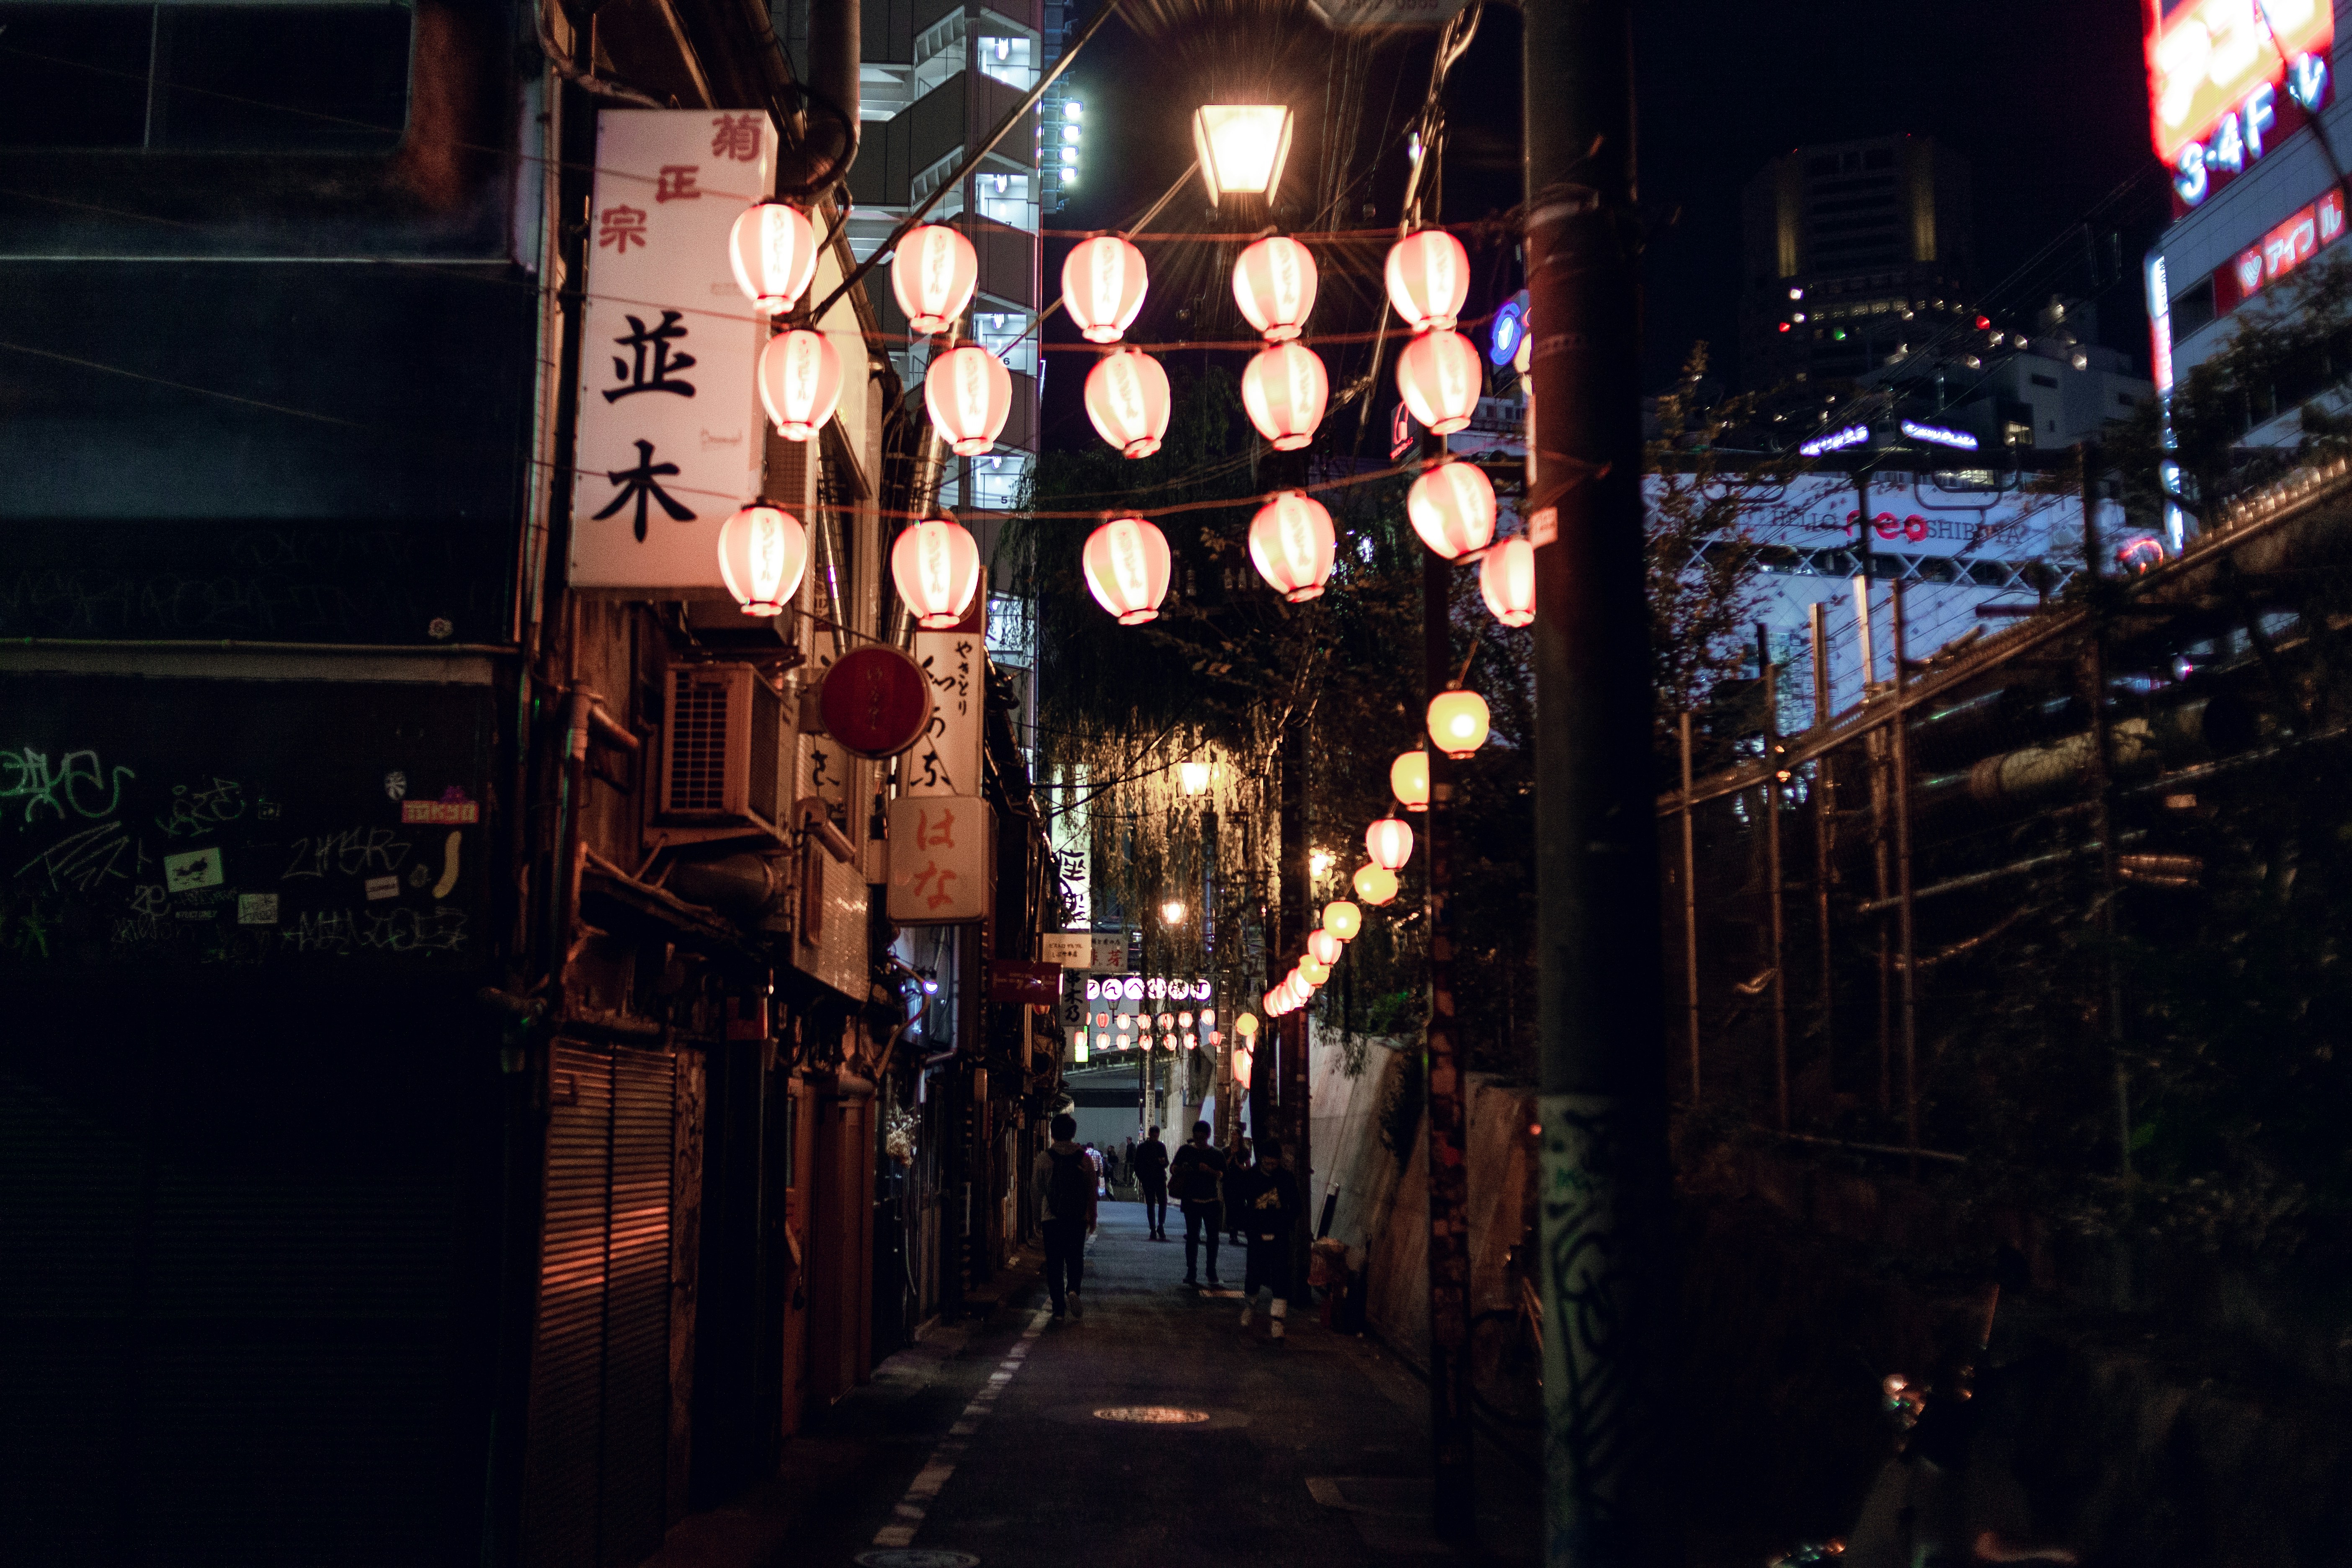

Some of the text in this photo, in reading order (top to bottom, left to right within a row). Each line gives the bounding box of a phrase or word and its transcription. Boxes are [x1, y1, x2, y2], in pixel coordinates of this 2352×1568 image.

[599, 115, 762, 254] 菊正宗
[2267, 204, 2341, 273] アイフル
[591, 310, 696, 543] 並木
[1927, 519, 2022, 544] SHIBYA
[956, 641, 972, 715] やきとり
[913, 808, 957, 910] はな
